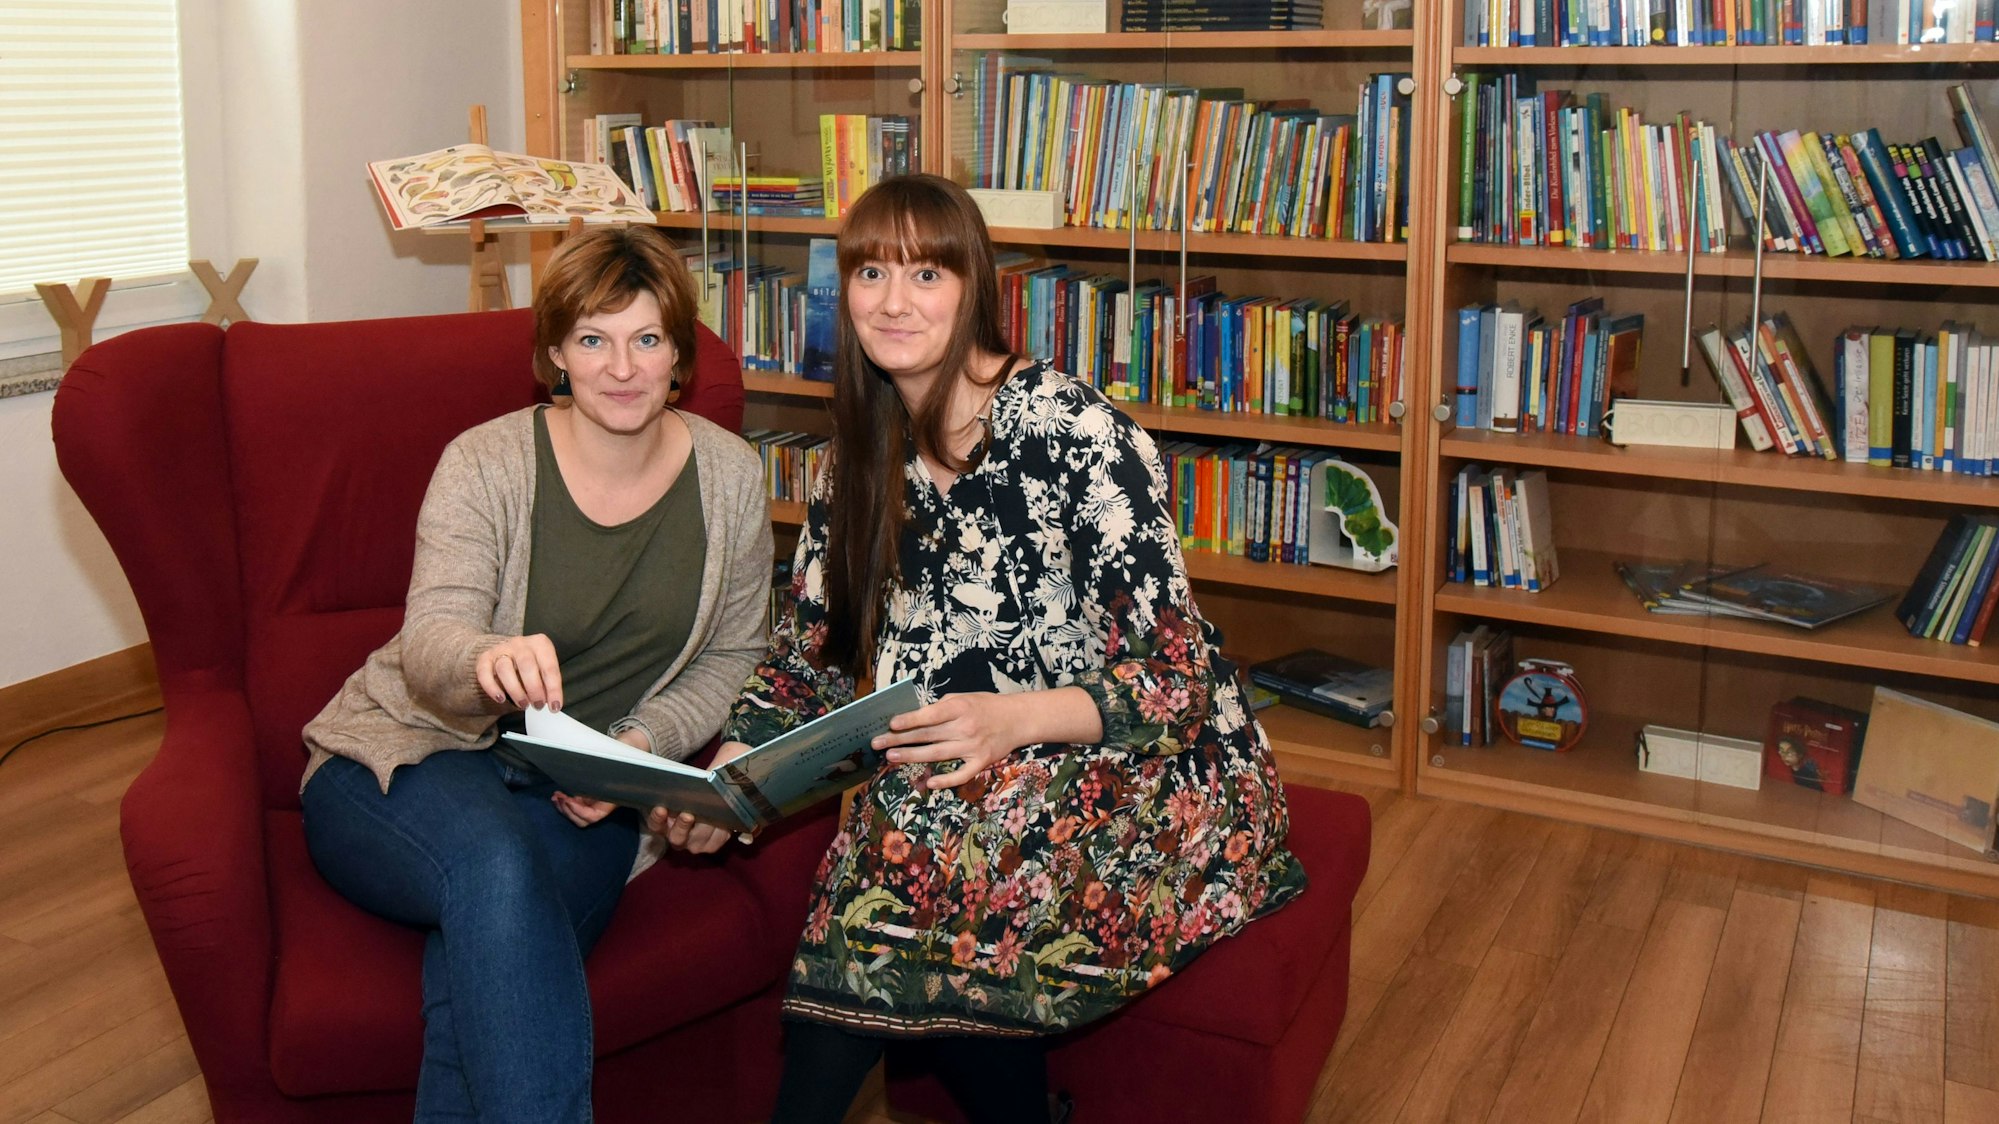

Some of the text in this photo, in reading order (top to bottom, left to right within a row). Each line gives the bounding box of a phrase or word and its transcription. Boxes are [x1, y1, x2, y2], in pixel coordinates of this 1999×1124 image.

[1548, 110, 1557, 136] Vorlesen
[1522, 164, 1531, 211] inder-Bibel
[813, 288, 840, 297] Bild
[1506, 324, 1517, 378] ROBERT ENKE
